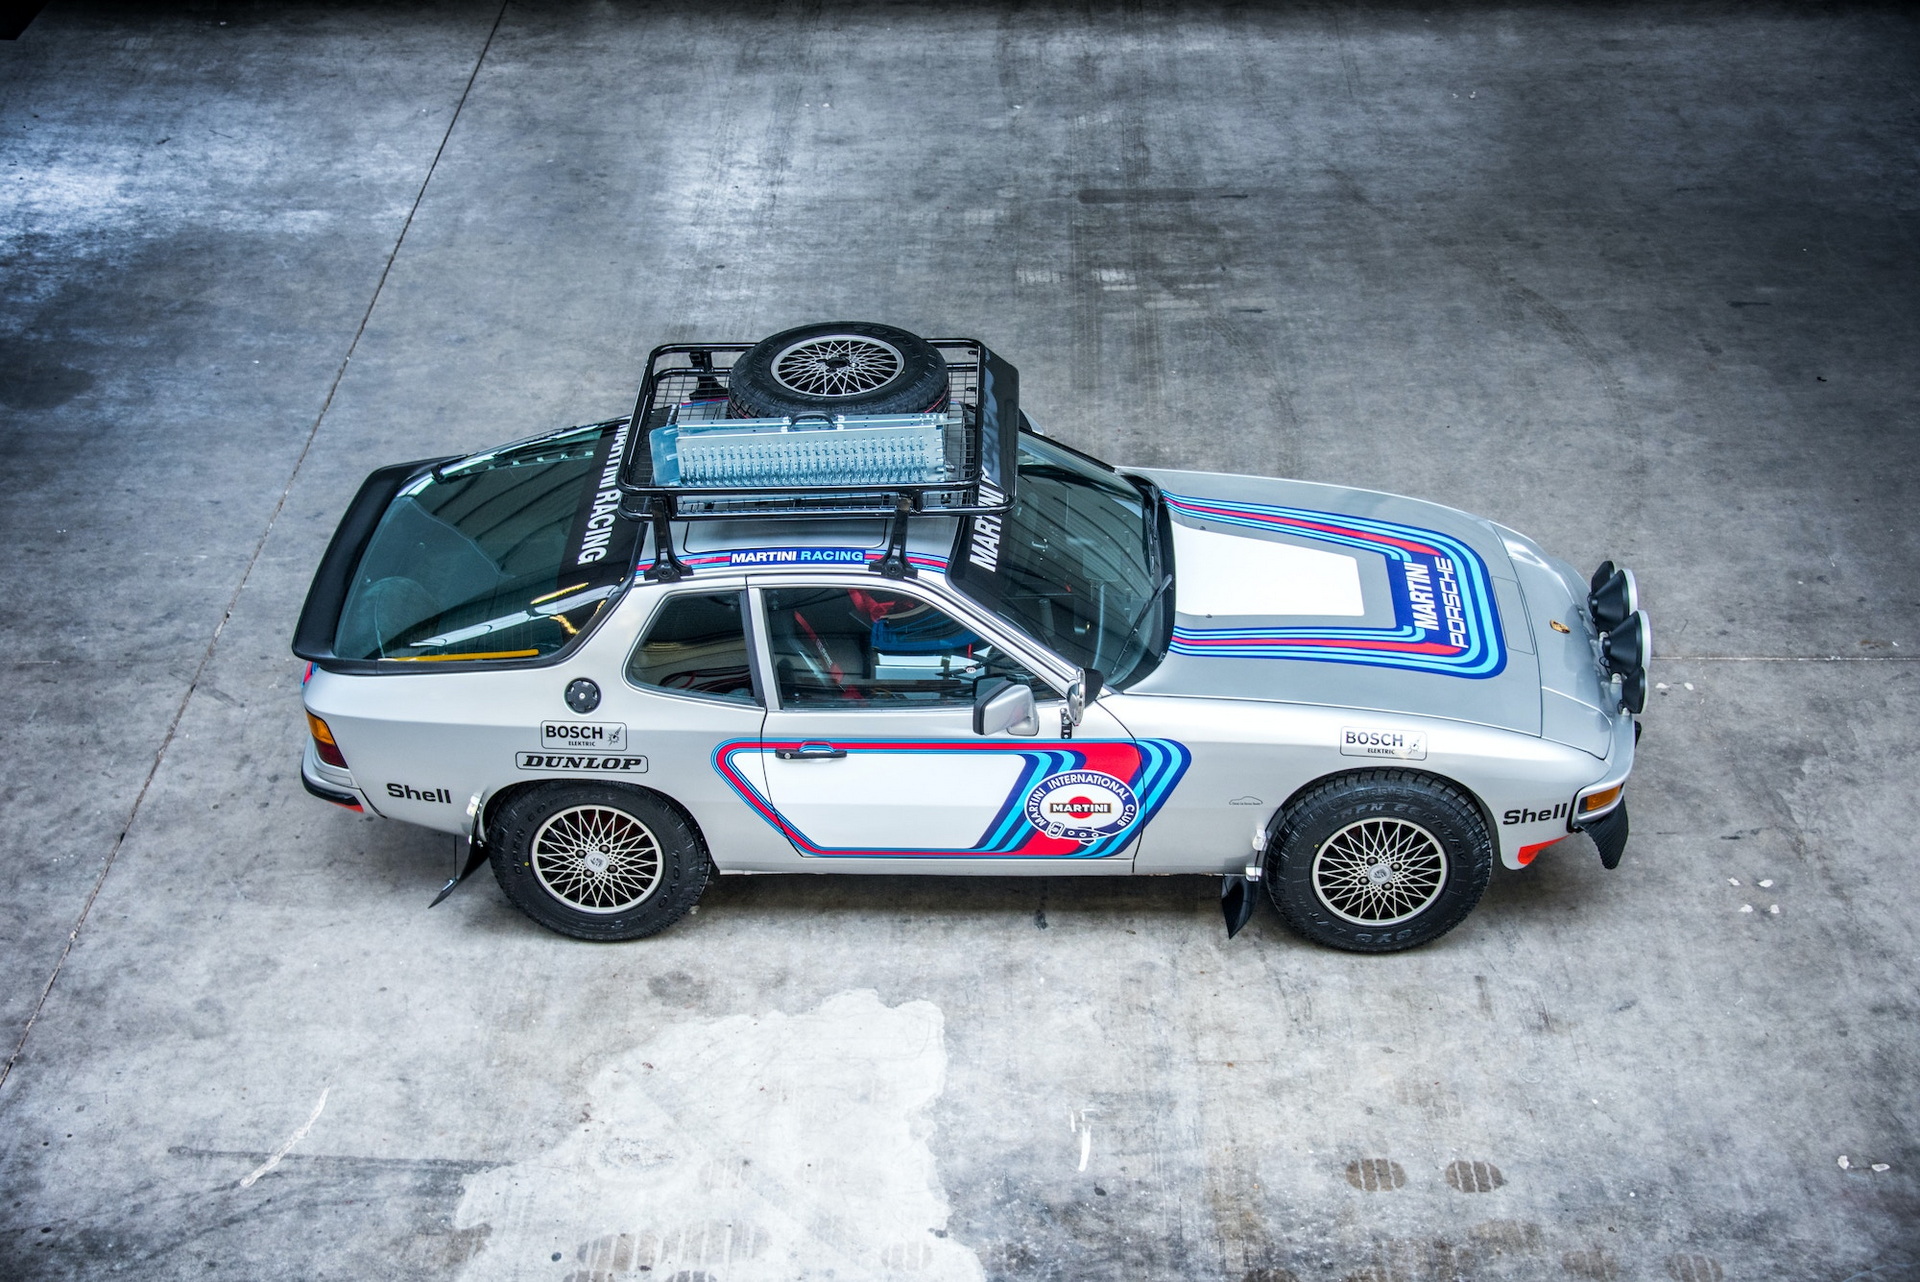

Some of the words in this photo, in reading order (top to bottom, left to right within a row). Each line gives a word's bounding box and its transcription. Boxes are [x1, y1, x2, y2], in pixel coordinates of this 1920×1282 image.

[577, 488, 622, 565] RACING
[969, 484, 1004, 572] MARTNI
[731, 551, 797, 563] MARTINI
[800, 550, 864, 561] RACING
[1403, 561, 1440, 631] MARTINI
[1434, 556, 1469, 649] PORSCHE
[545, 725, 603, 740] BOSCH
[1345, 731, 1404, 747] BOSCH
[1367, 747, 1396, 755] ELEKTRIC
[522, 755, 642, 770] DUNLOP
[386, 782, 452, 804] Shell
[1028, 787, 1047, 827] MARTINI
[1047, 774, 1130, 801] INTERNATIONAL
[1117, 804, 1136, 827] CLUB
[1052, 804, 1108, 812] MARTINI
[1502, 803, 1568, 825] Shell
